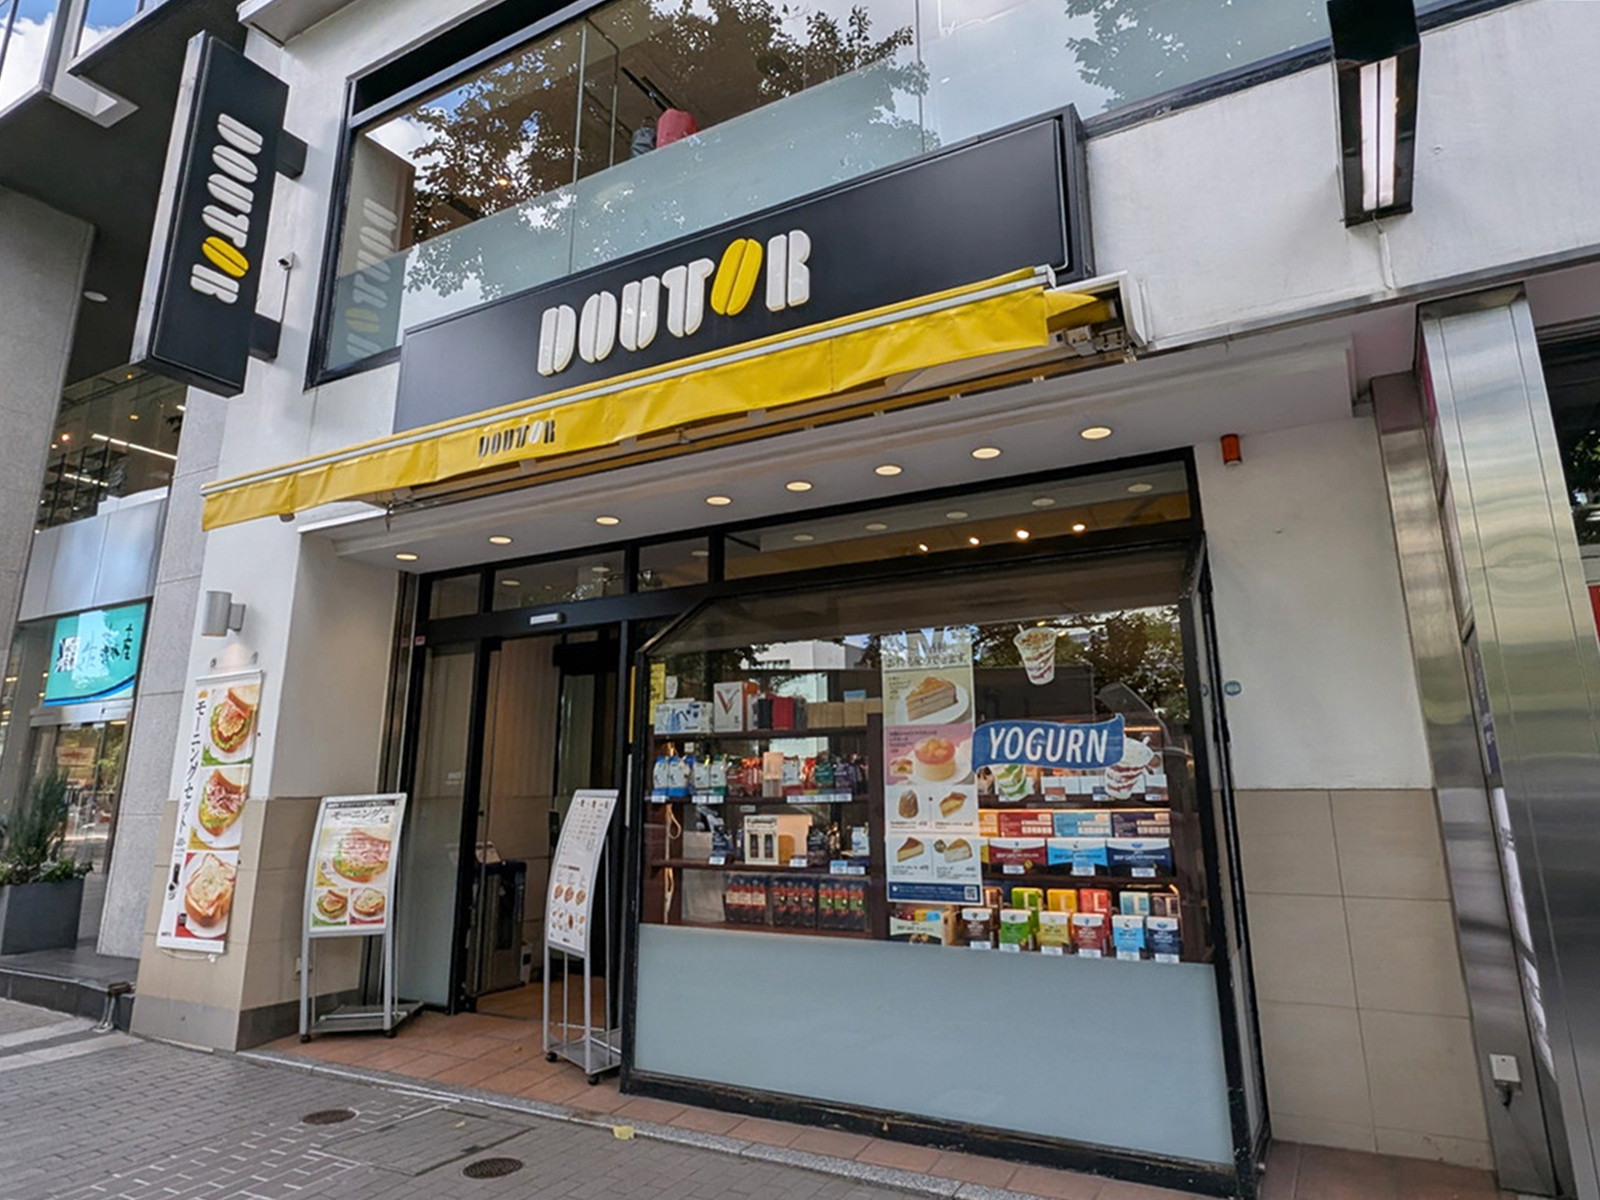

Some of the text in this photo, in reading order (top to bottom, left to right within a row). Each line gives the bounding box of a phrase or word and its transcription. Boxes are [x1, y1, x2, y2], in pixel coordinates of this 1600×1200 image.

[190, 113, 264, 304] DOUTOR
[537, 229, 811, 376] DOUTOR
[478, 419, 555, 457] DOUTOR
[179, 700, 206, 833] モーニングセット
[989, 726, 1109, 764] YOGURN
